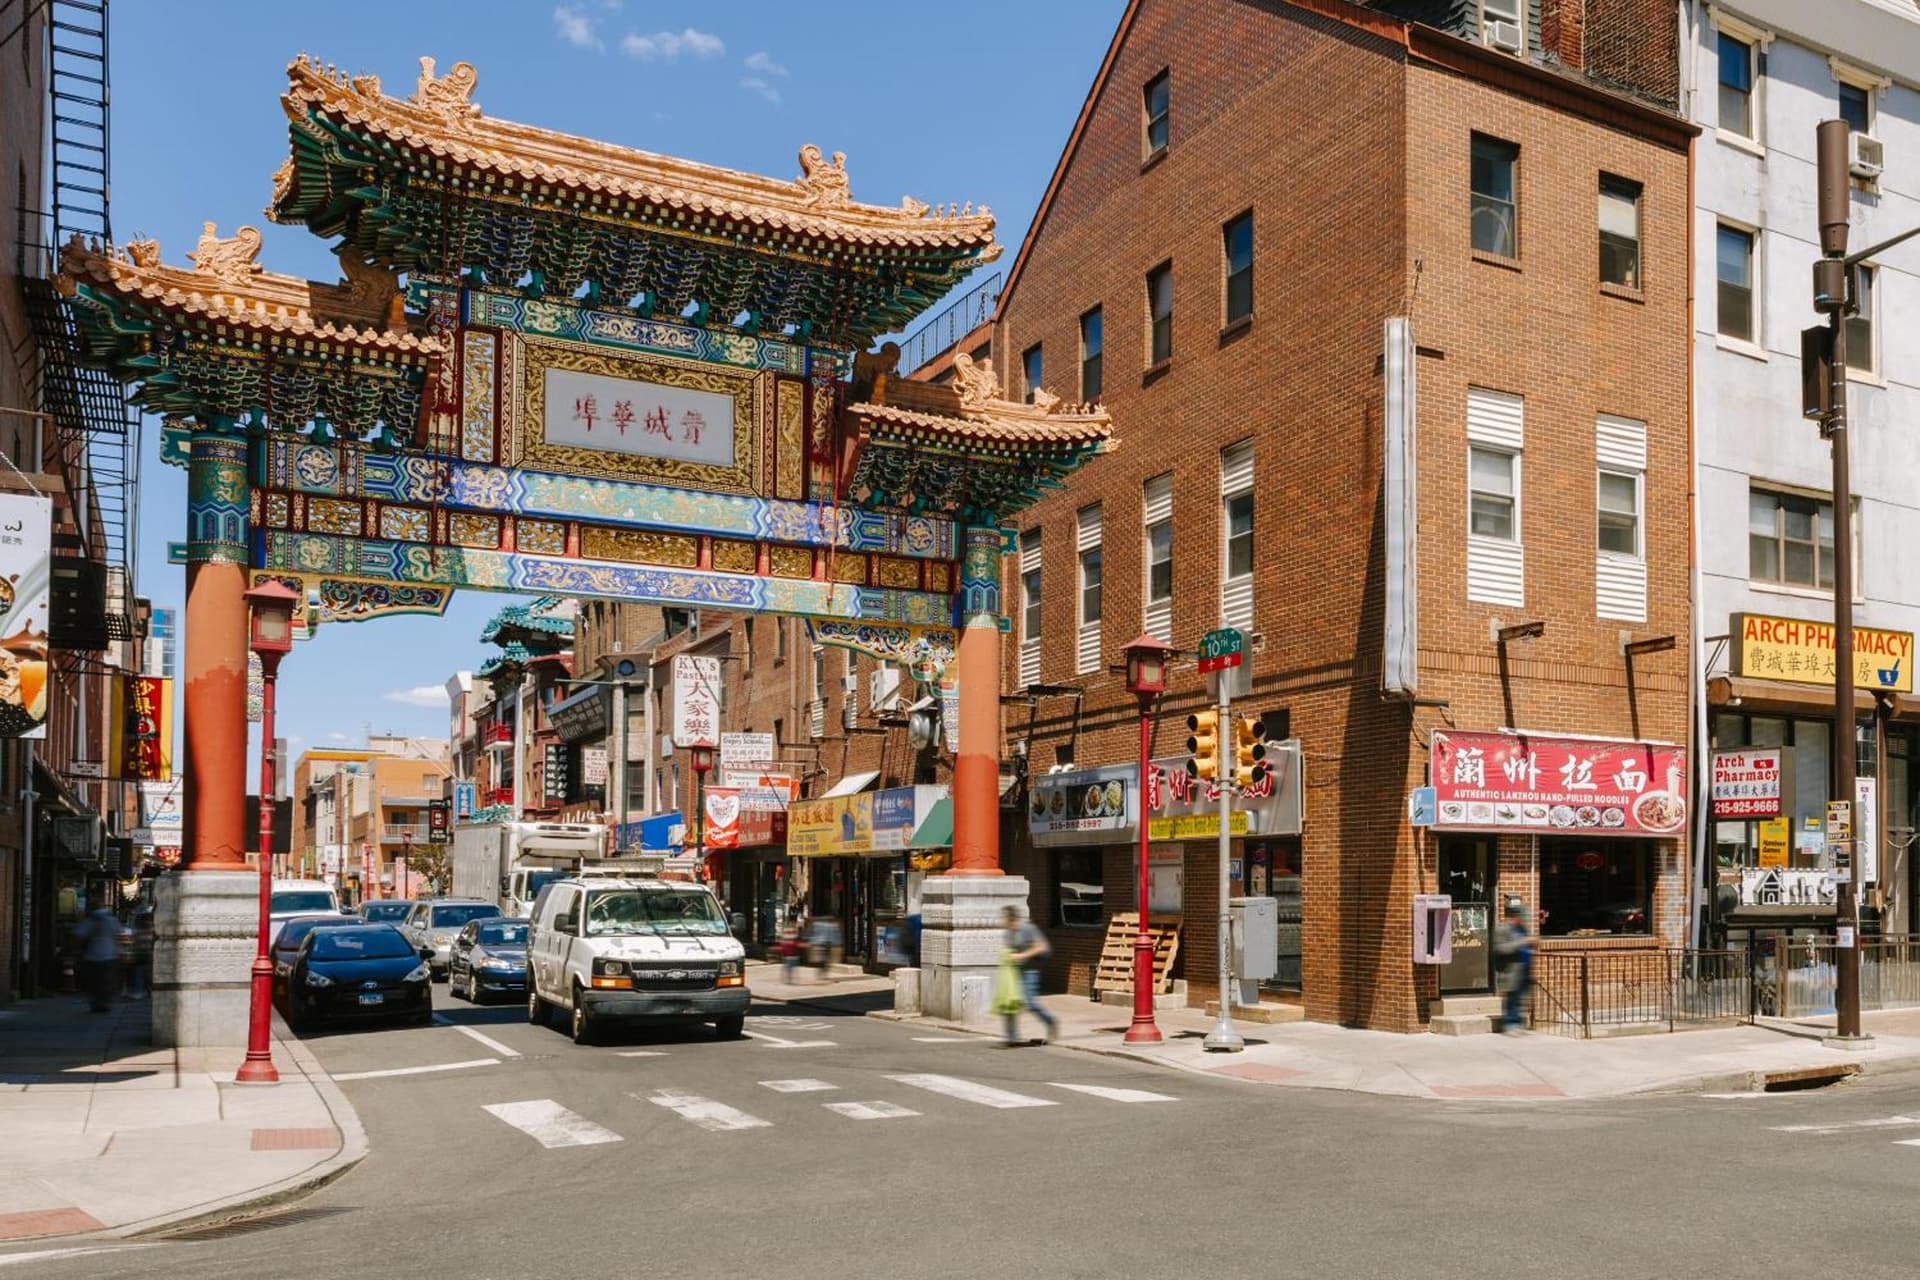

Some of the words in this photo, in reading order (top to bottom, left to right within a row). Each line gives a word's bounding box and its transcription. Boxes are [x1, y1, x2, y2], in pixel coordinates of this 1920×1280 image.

[1745, 618, 1799, 646] ARCH
[1231, 640, 1241, 652] ST
[1749, 646, 1872, 683] 費城華埠大房
[676, 670, 718, 681] Pastries
[683, 681, 712, 735] 大家樂
[1715, 754, 1745, 769] Arch
[1453, 746, 1648, 794] 蘭州拉面
[1715, 769, 1779, 783] Pharmacy
[1453, 789, 1500, 800] AUTHENTIC
[1501, 791, 1541, 803] LANZHOU
[1541, 793, 1594, 804] HAND-PULLED
[1594, 795, 1629, 805] NOODLES
[1714, 800, 1780, 815] 215-925-9666
